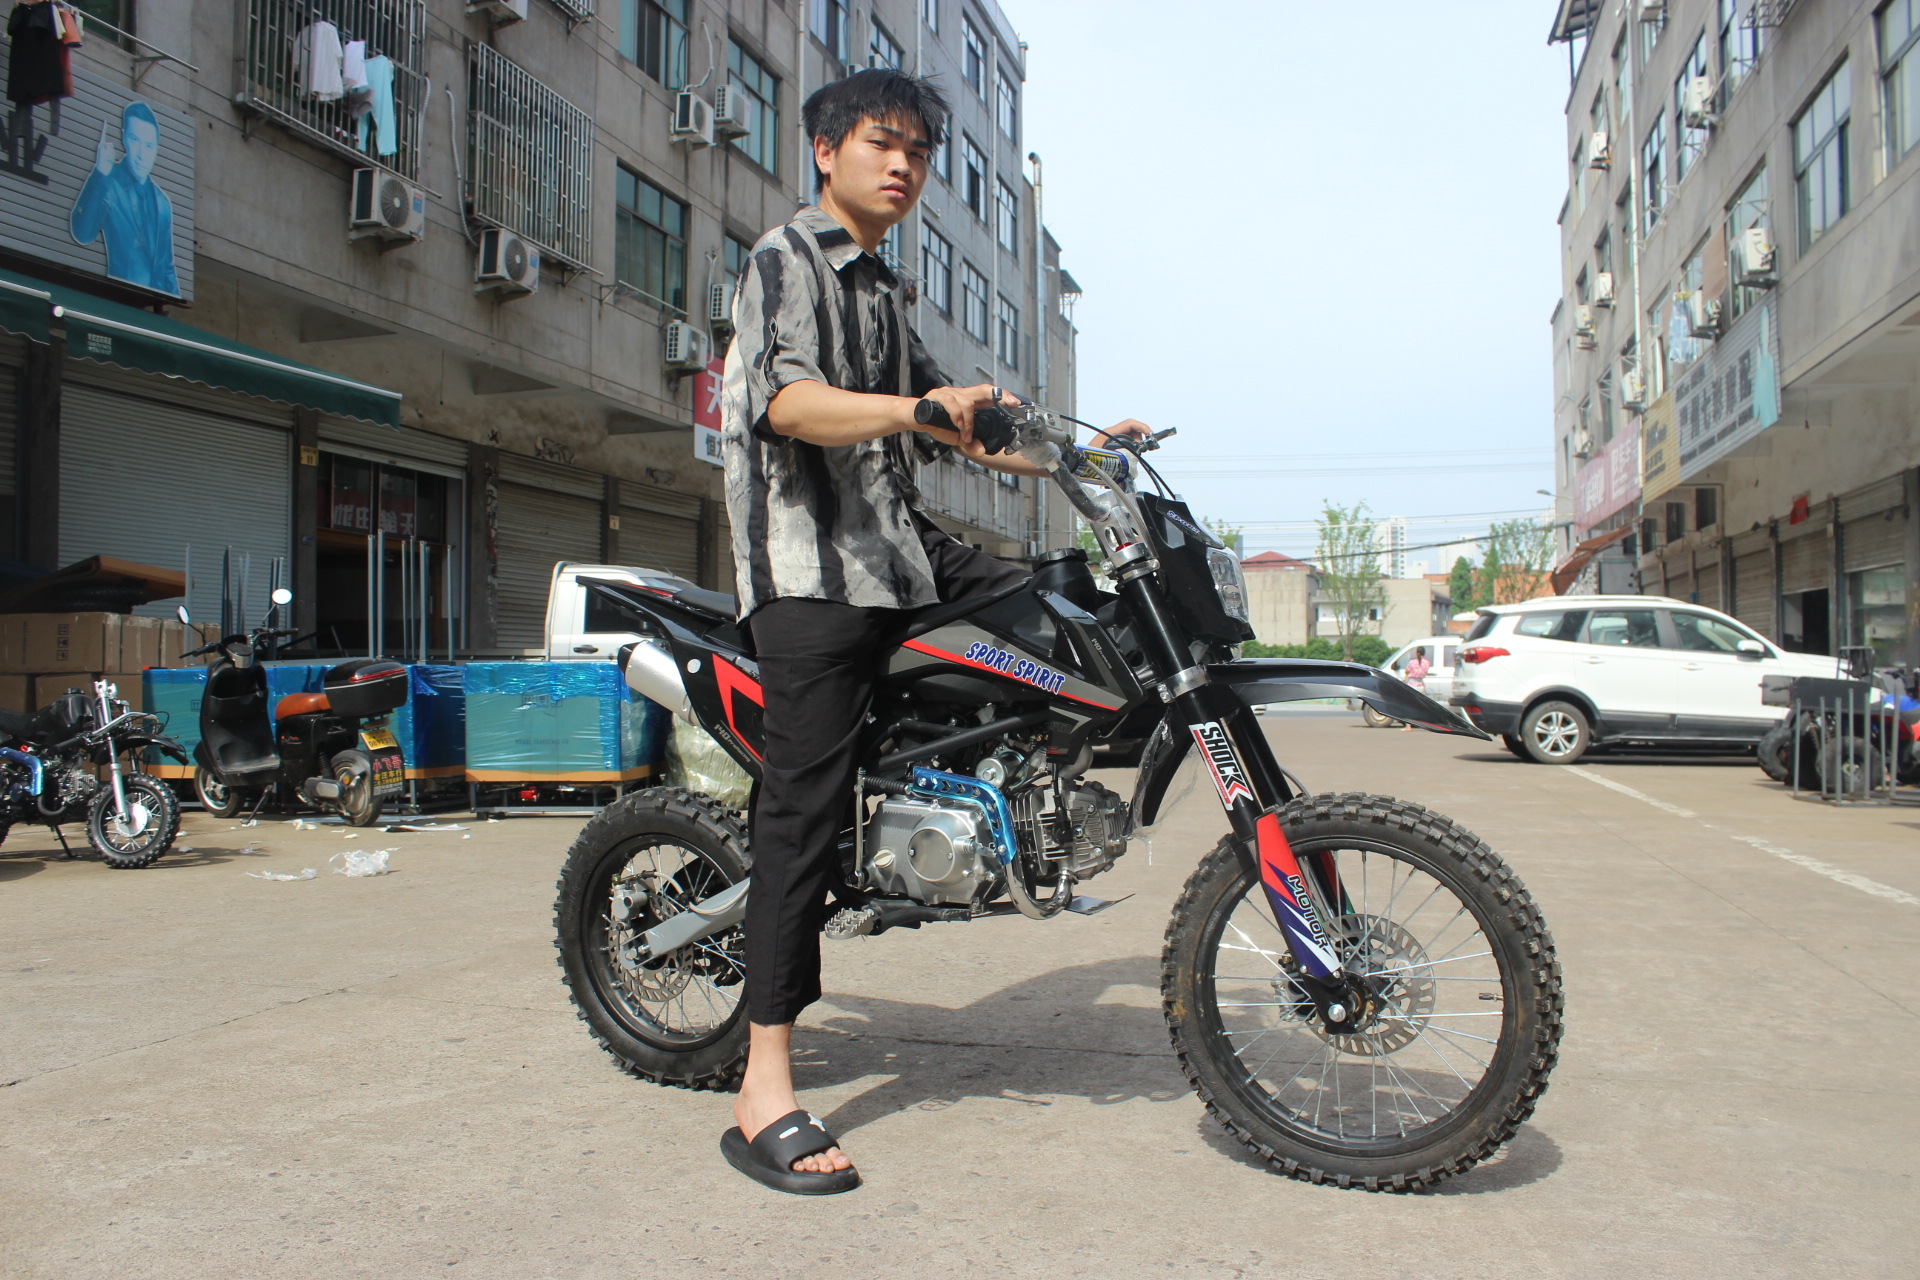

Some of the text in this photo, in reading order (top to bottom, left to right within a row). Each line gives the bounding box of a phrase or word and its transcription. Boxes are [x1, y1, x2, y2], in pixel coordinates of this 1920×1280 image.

[965, 641, 1066, 695] SPORT SPIRIT
[713, 723, 730, 742] 140
[1199, 725, 1248, 792] SHOCK
[372, 754, 402, 773] 小飞哥
[1287, 874, 1329, 949] MOTOR
